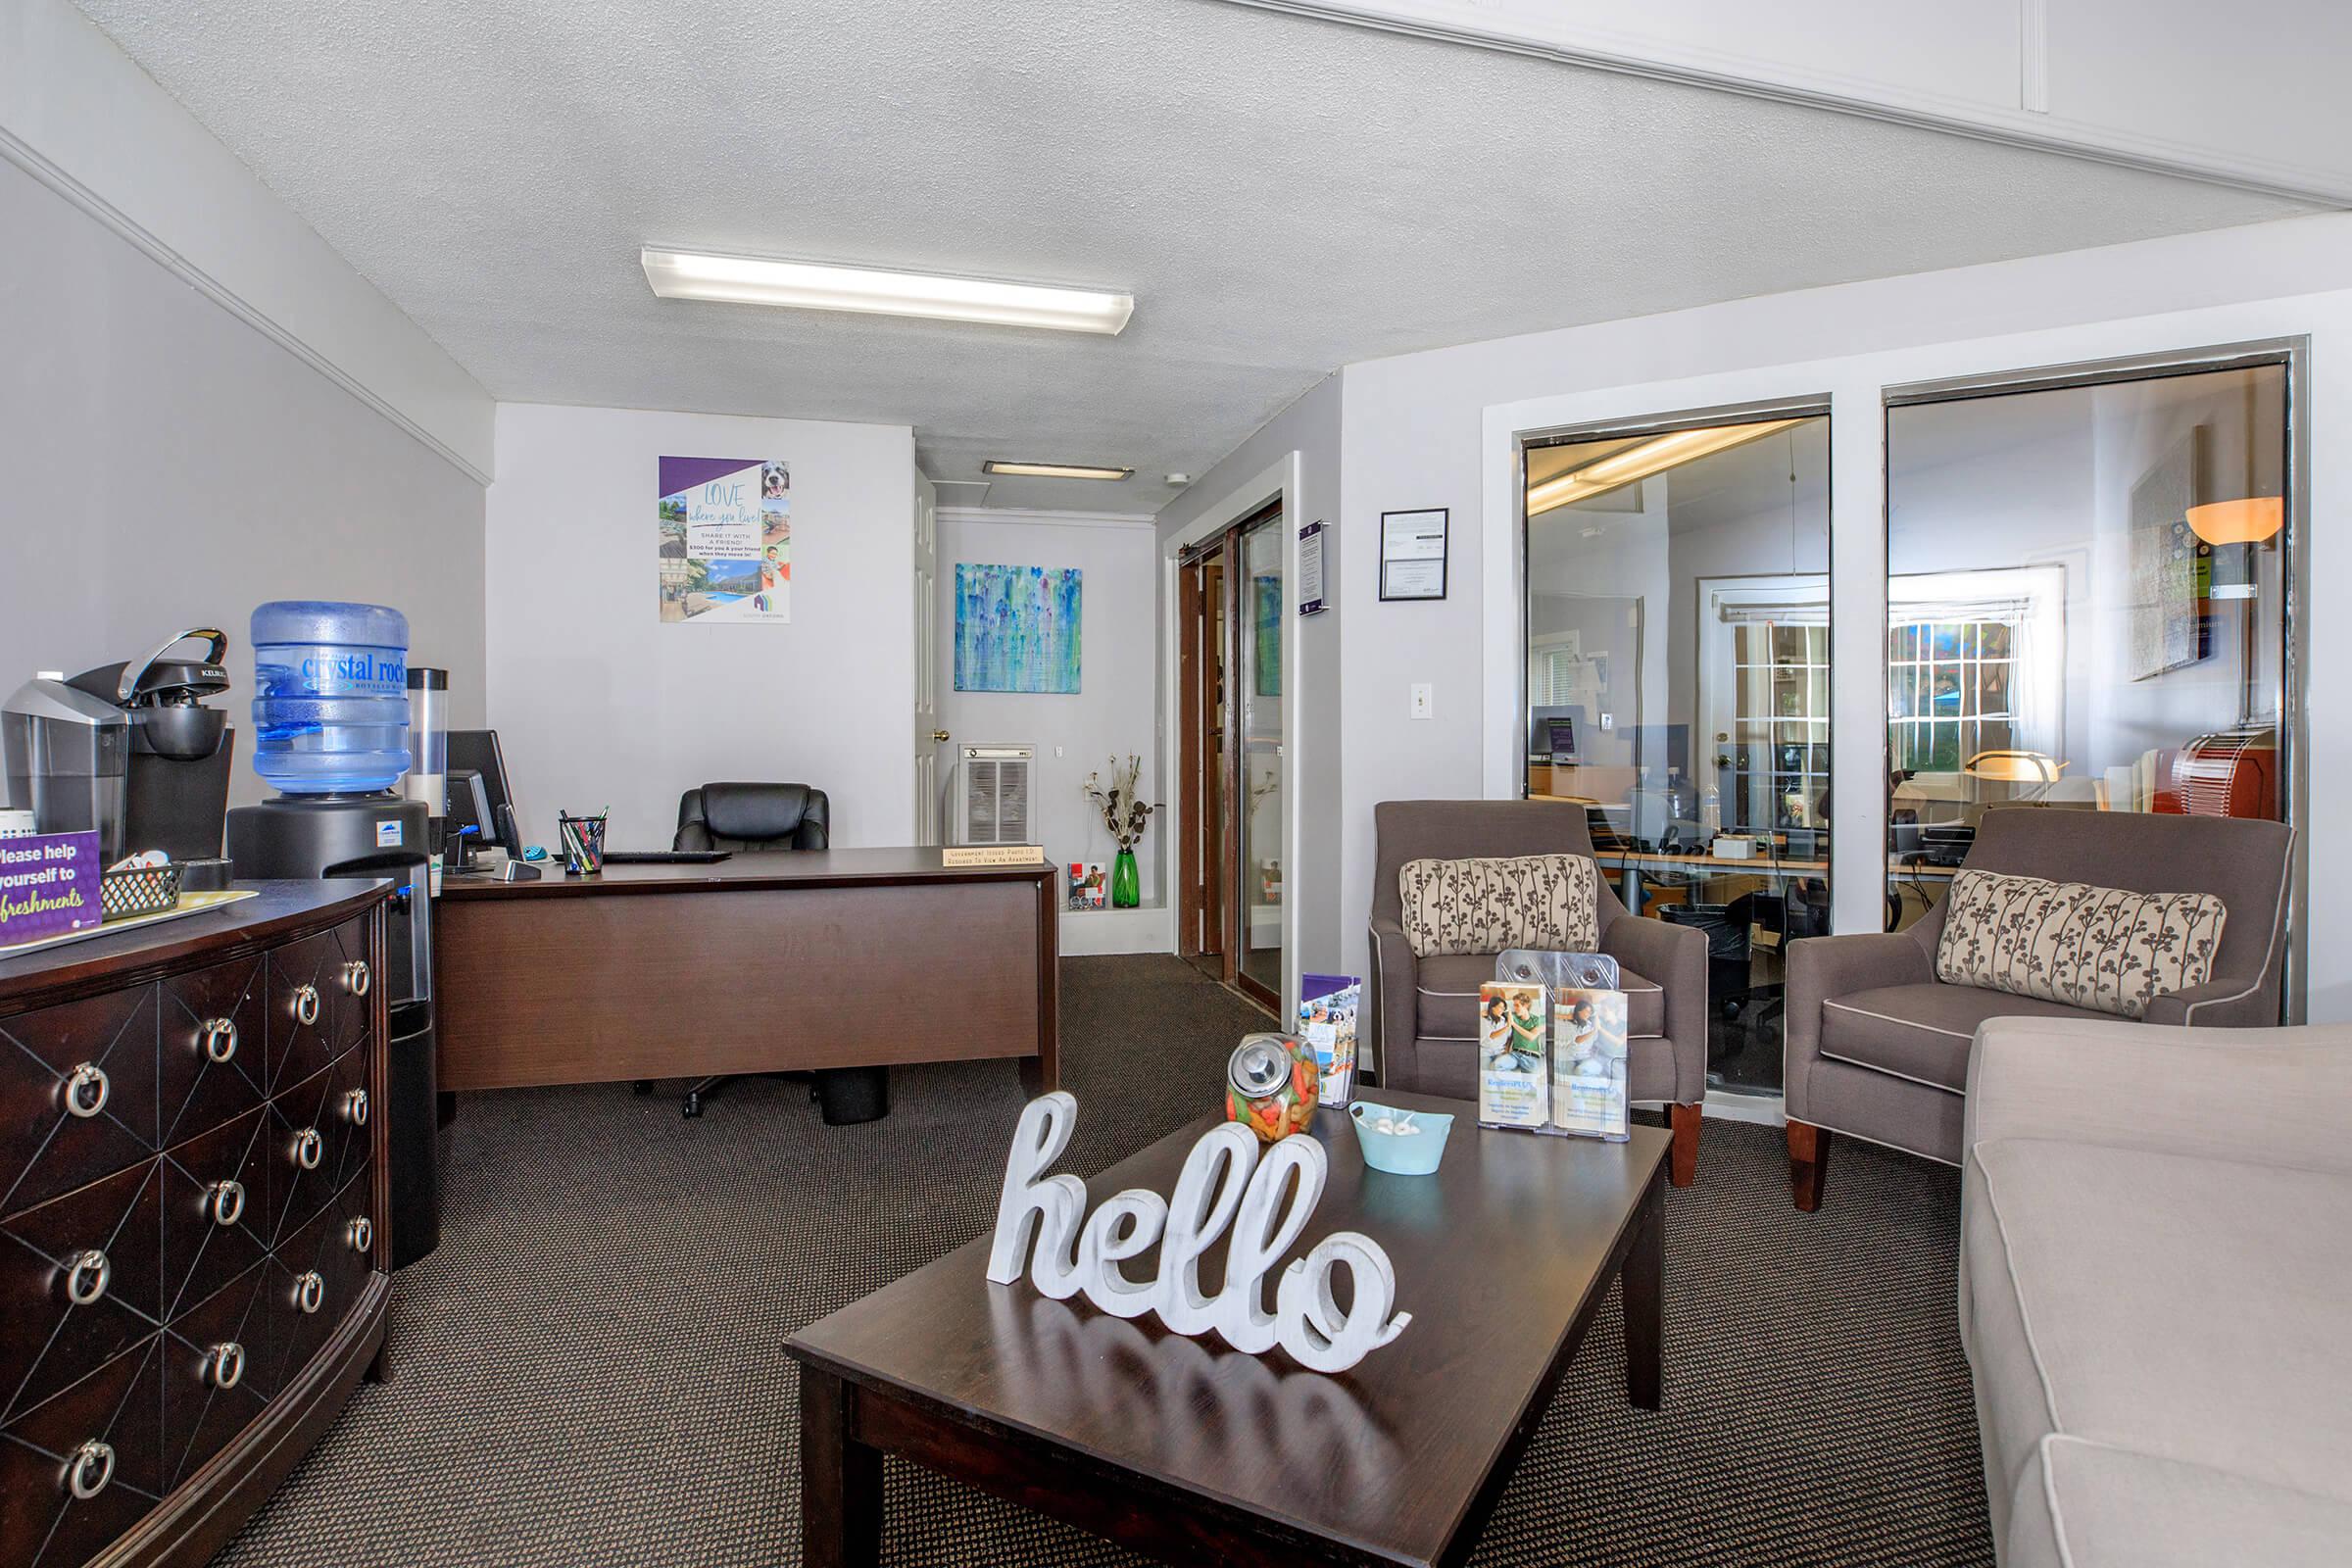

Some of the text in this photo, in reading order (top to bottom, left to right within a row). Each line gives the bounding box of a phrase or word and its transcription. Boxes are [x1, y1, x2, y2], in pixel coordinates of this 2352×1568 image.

[706, 483, 745, 507] LOVE
[689, 505, 714, 521] where
[715, 513, 735, 532] you
[0, 844, 77, 864] lease help
[60, 867, 75, 881] to
[987, 1091, 1412, 1373] hello
